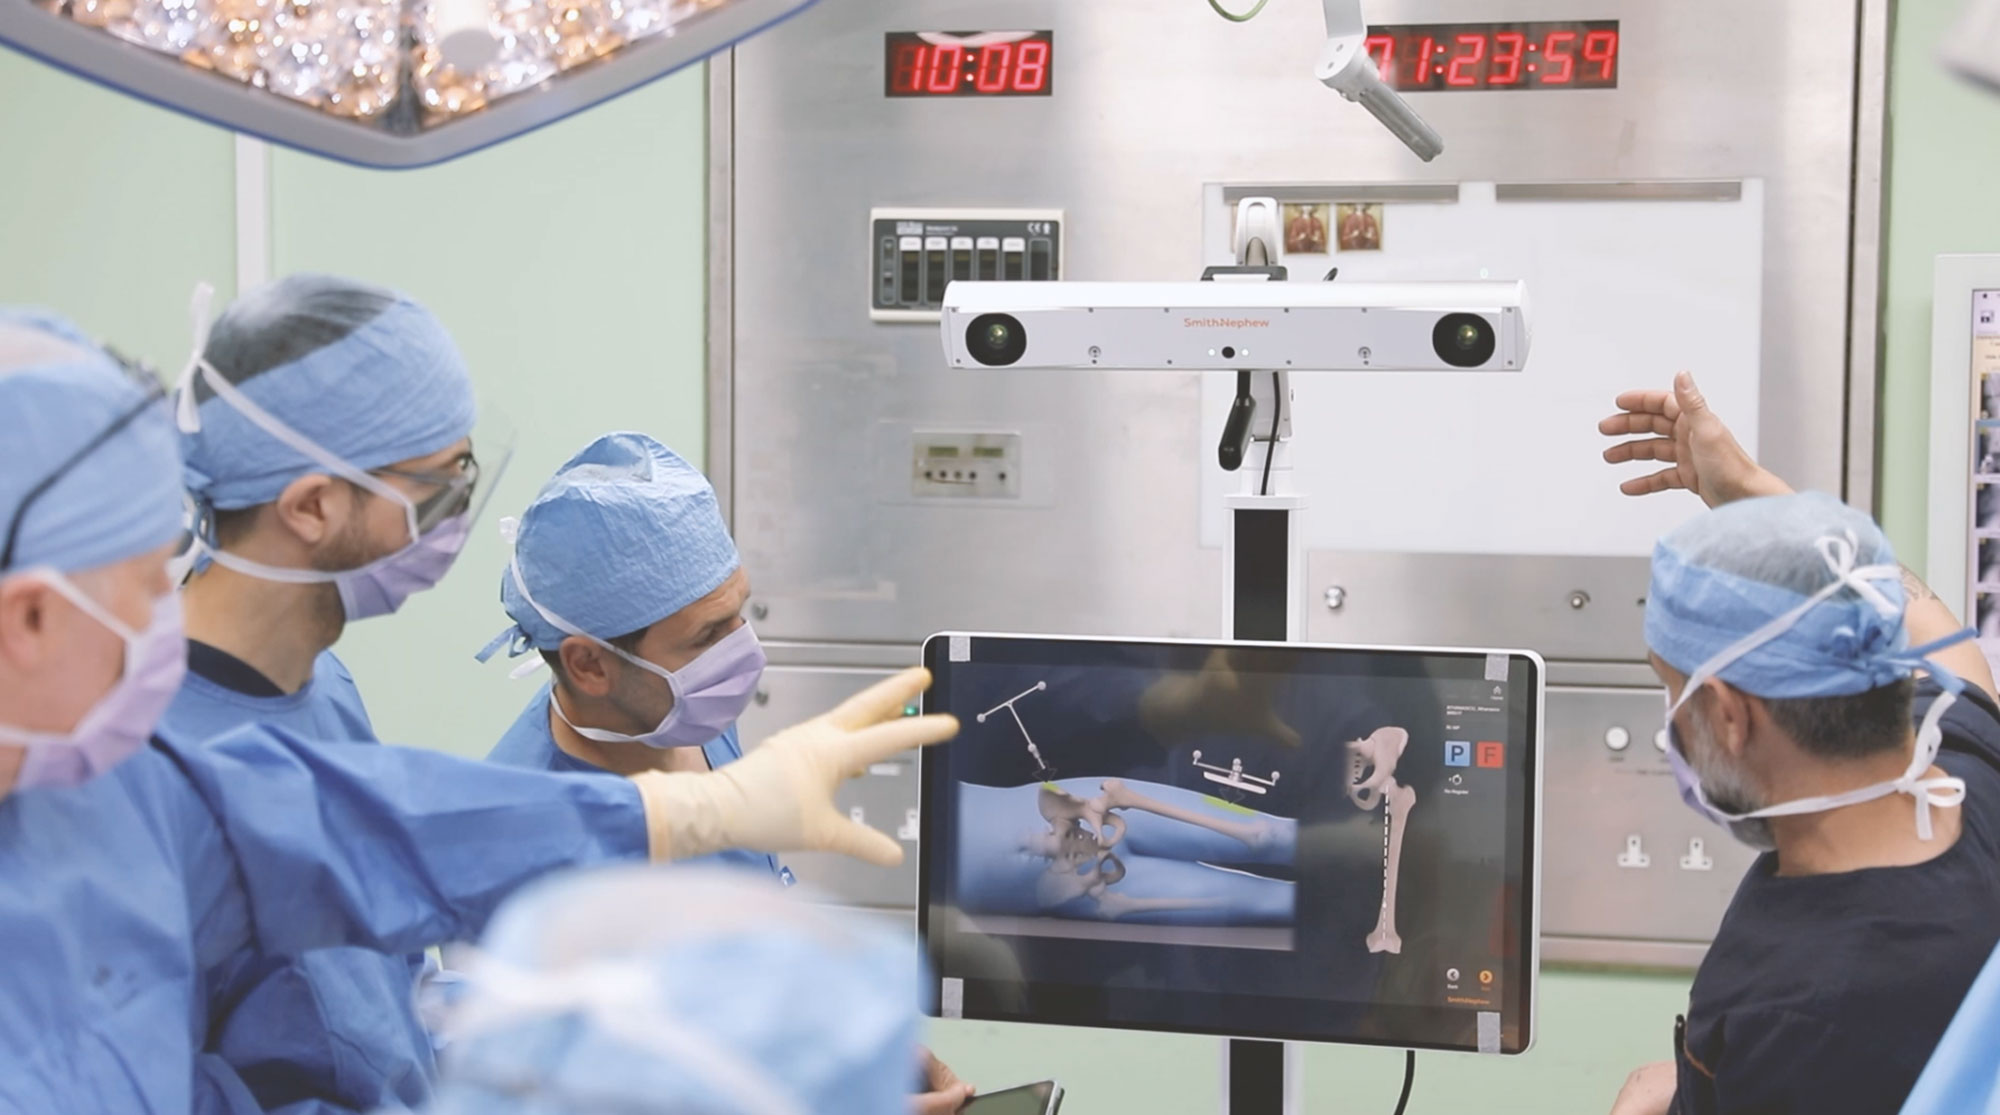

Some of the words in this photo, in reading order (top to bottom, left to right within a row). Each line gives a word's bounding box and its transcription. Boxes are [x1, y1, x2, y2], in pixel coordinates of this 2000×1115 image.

[912, 42, 1048, 92] 10:08
[1451, 745, 1464, 762] P
[1484, 746, 1497, 764] F
